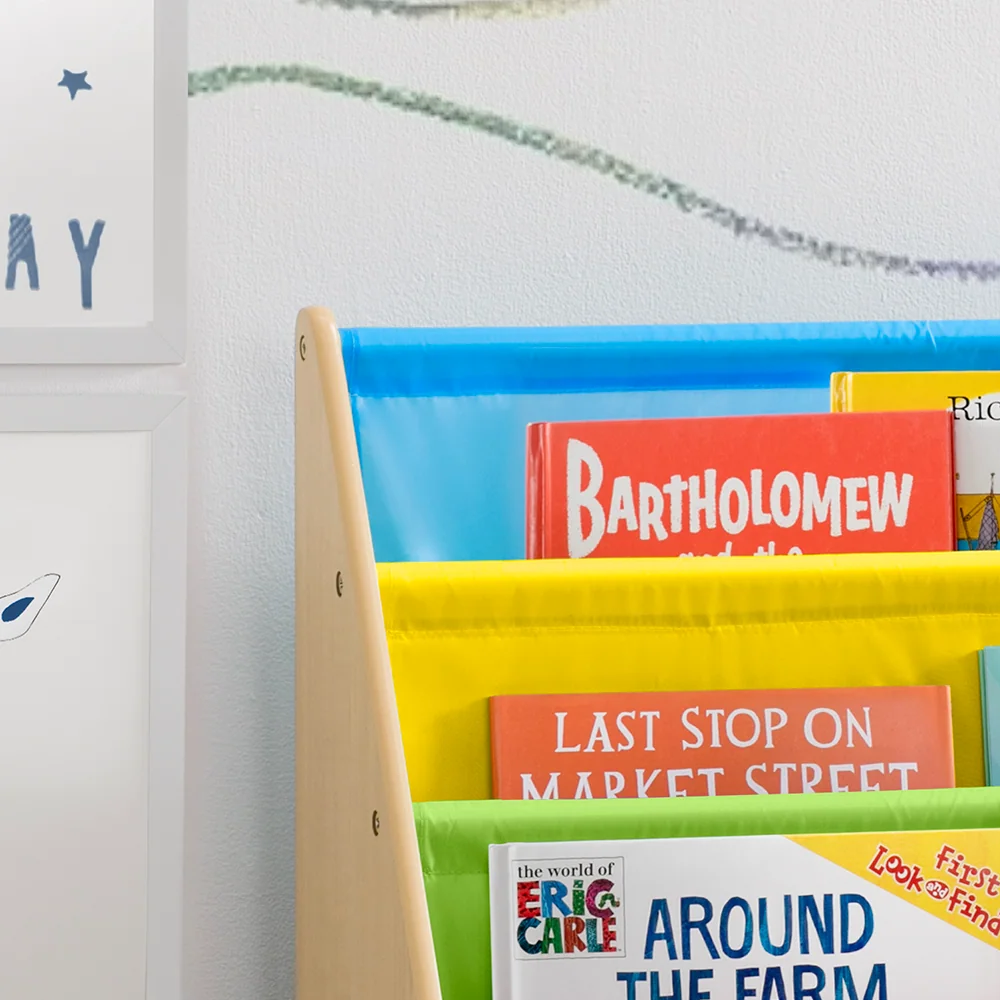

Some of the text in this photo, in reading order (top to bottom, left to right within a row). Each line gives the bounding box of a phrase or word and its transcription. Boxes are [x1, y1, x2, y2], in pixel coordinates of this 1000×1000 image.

[554, 706, 873, 753] LAST STOP ON
[518, 862, 615, 878] the world of
[868, 845, 924, 892] Look
[926, 881, 949, 899] and
[935, 845, 1000, 896] First
[517, 917, 617, 954] CARLE
[643, 894, 875, 960] AROUND
